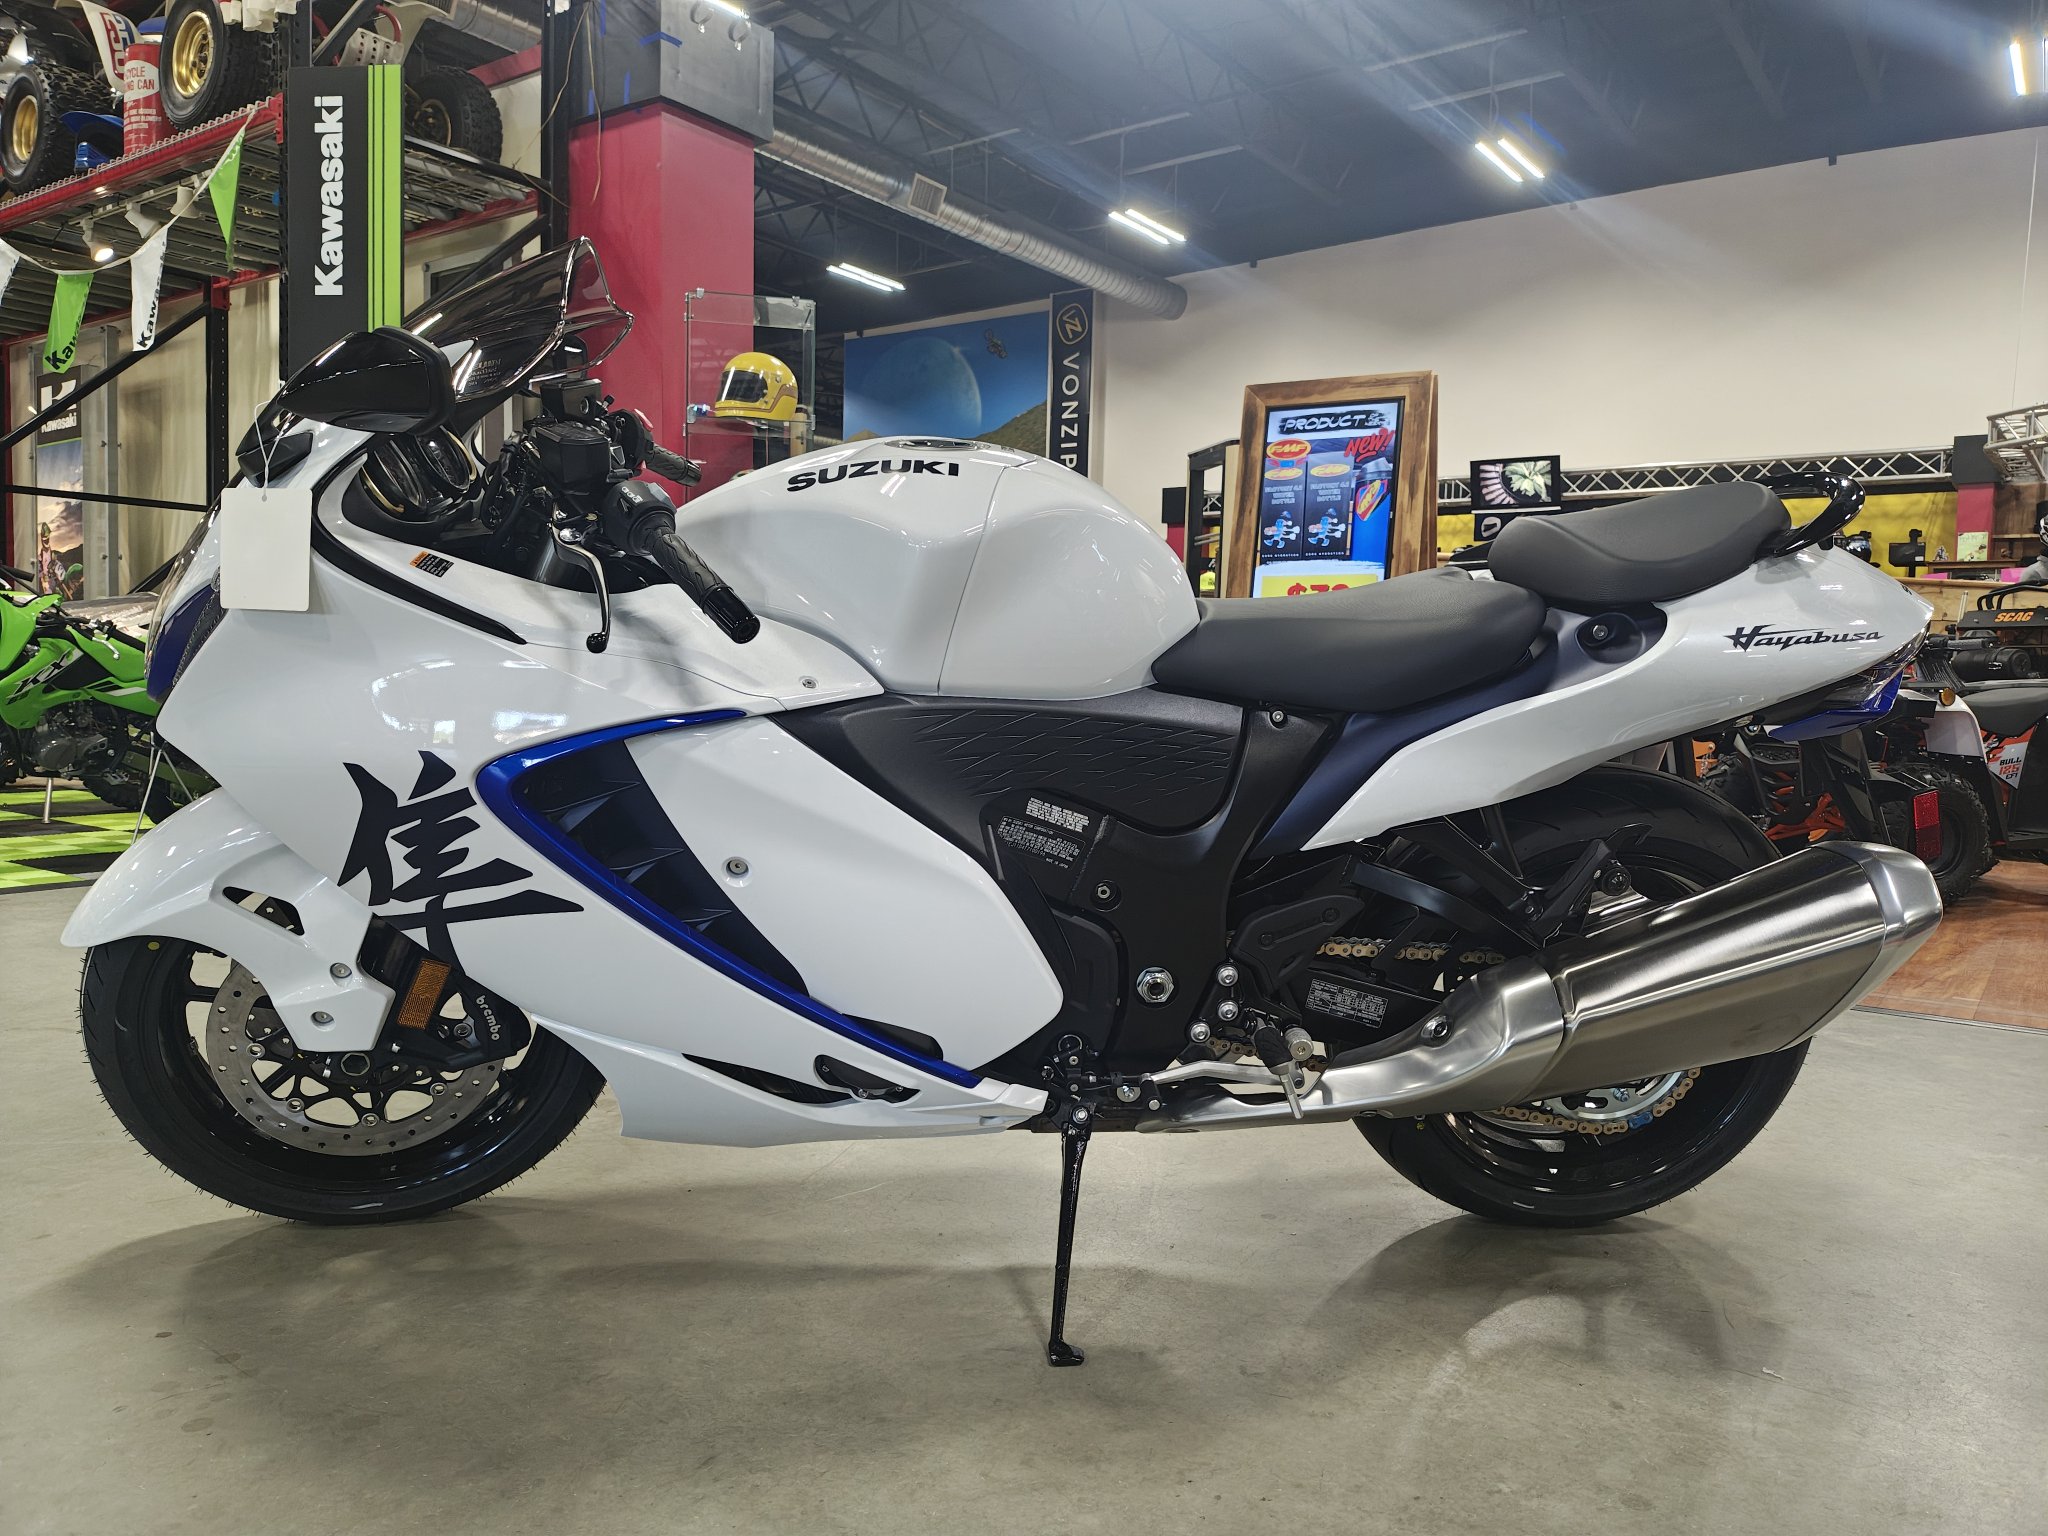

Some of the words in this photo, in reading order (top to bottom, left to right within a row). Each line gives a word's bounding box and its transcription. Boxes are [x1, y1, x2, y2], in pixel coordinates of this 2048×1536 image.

[137, 79, 155, 91] CAN
[314, 95, 344, 296] Kawasaki
[1060, 352, 1081, 470] VONZIP
[1283, 414, 1366, 432] PRODUCT
[787, 459, 959, 492] SUZUKI
[1994, 611, 2034, 622] SCAG
[1722, 623, 1886, 653] Hayabusa
[1999, 757, 2022, 766] BULL
[1999, 764, 2020, 775] 125
[336, 750, 585, 976] 隼
[475, 995, 501, 1042] brembo
